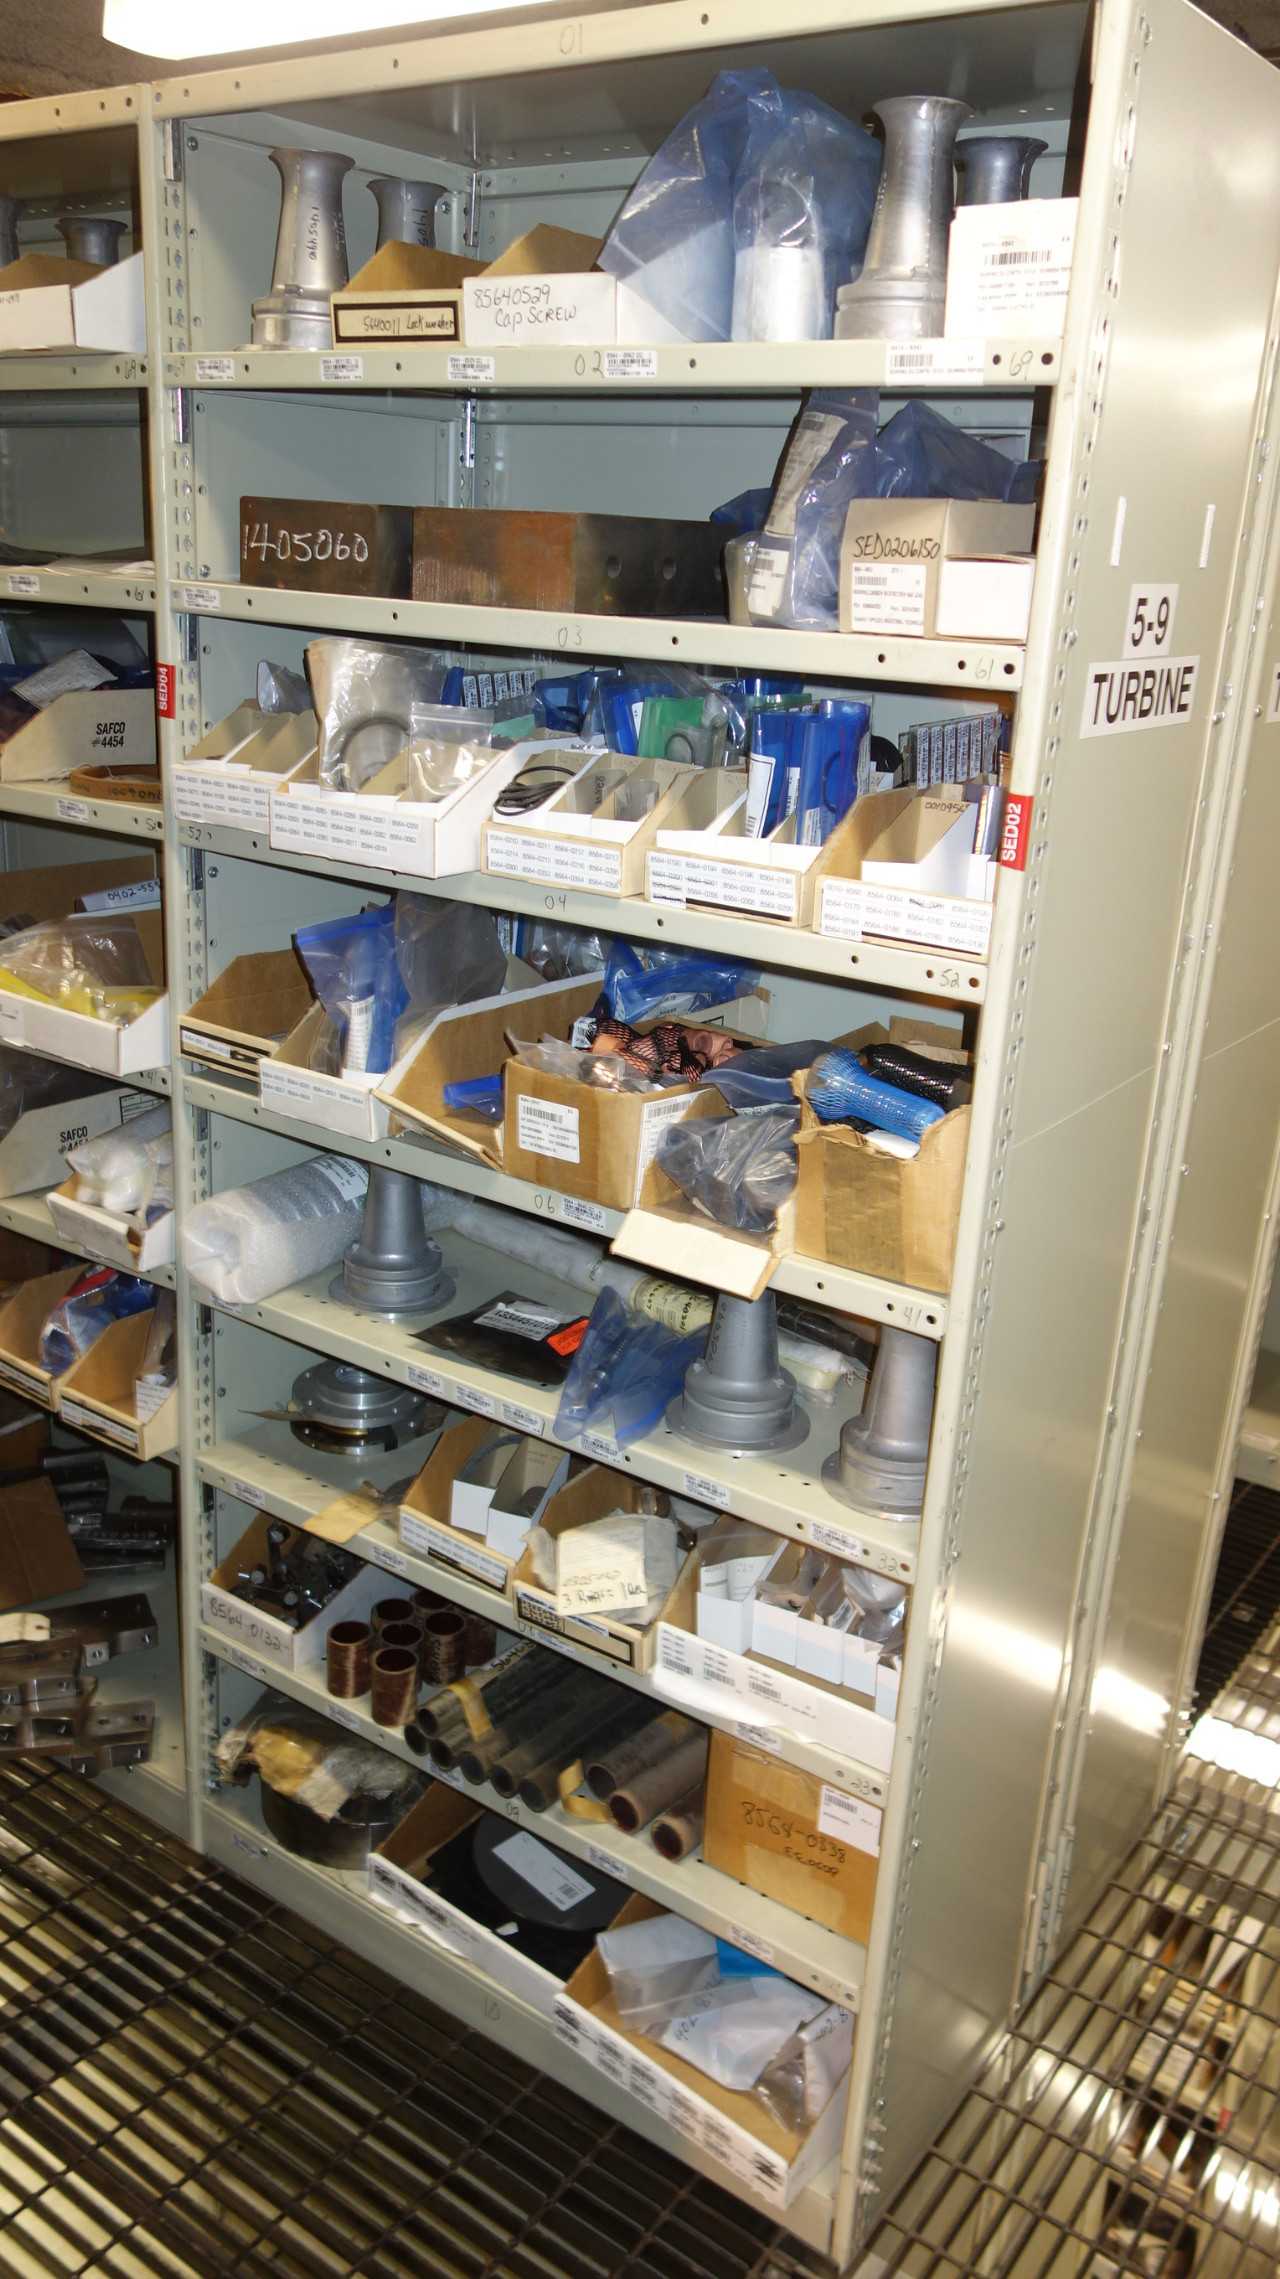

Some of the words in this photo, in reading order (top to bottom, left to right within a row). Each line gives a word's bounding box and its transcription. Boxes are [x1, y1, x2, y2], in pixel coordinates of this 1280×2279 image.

[473, 284, 551, 309] 85640529
[494, 308, 523, 332] Cap
[527, 305, 577, 325] SCREW
[242, 523, 369, 562] 1405060
[1131, 597, 1170, 647] 5-9
[158, 666, 168, 711] SED04
[1093, 665, 1195, 726] TURBINE
[96, 721, 126, 736] SAFCO
[1001, 803, 1022, 862] SED02
[544, 894, 567, 913] 04
[60, 1126, 89, 1143] SAFCO
